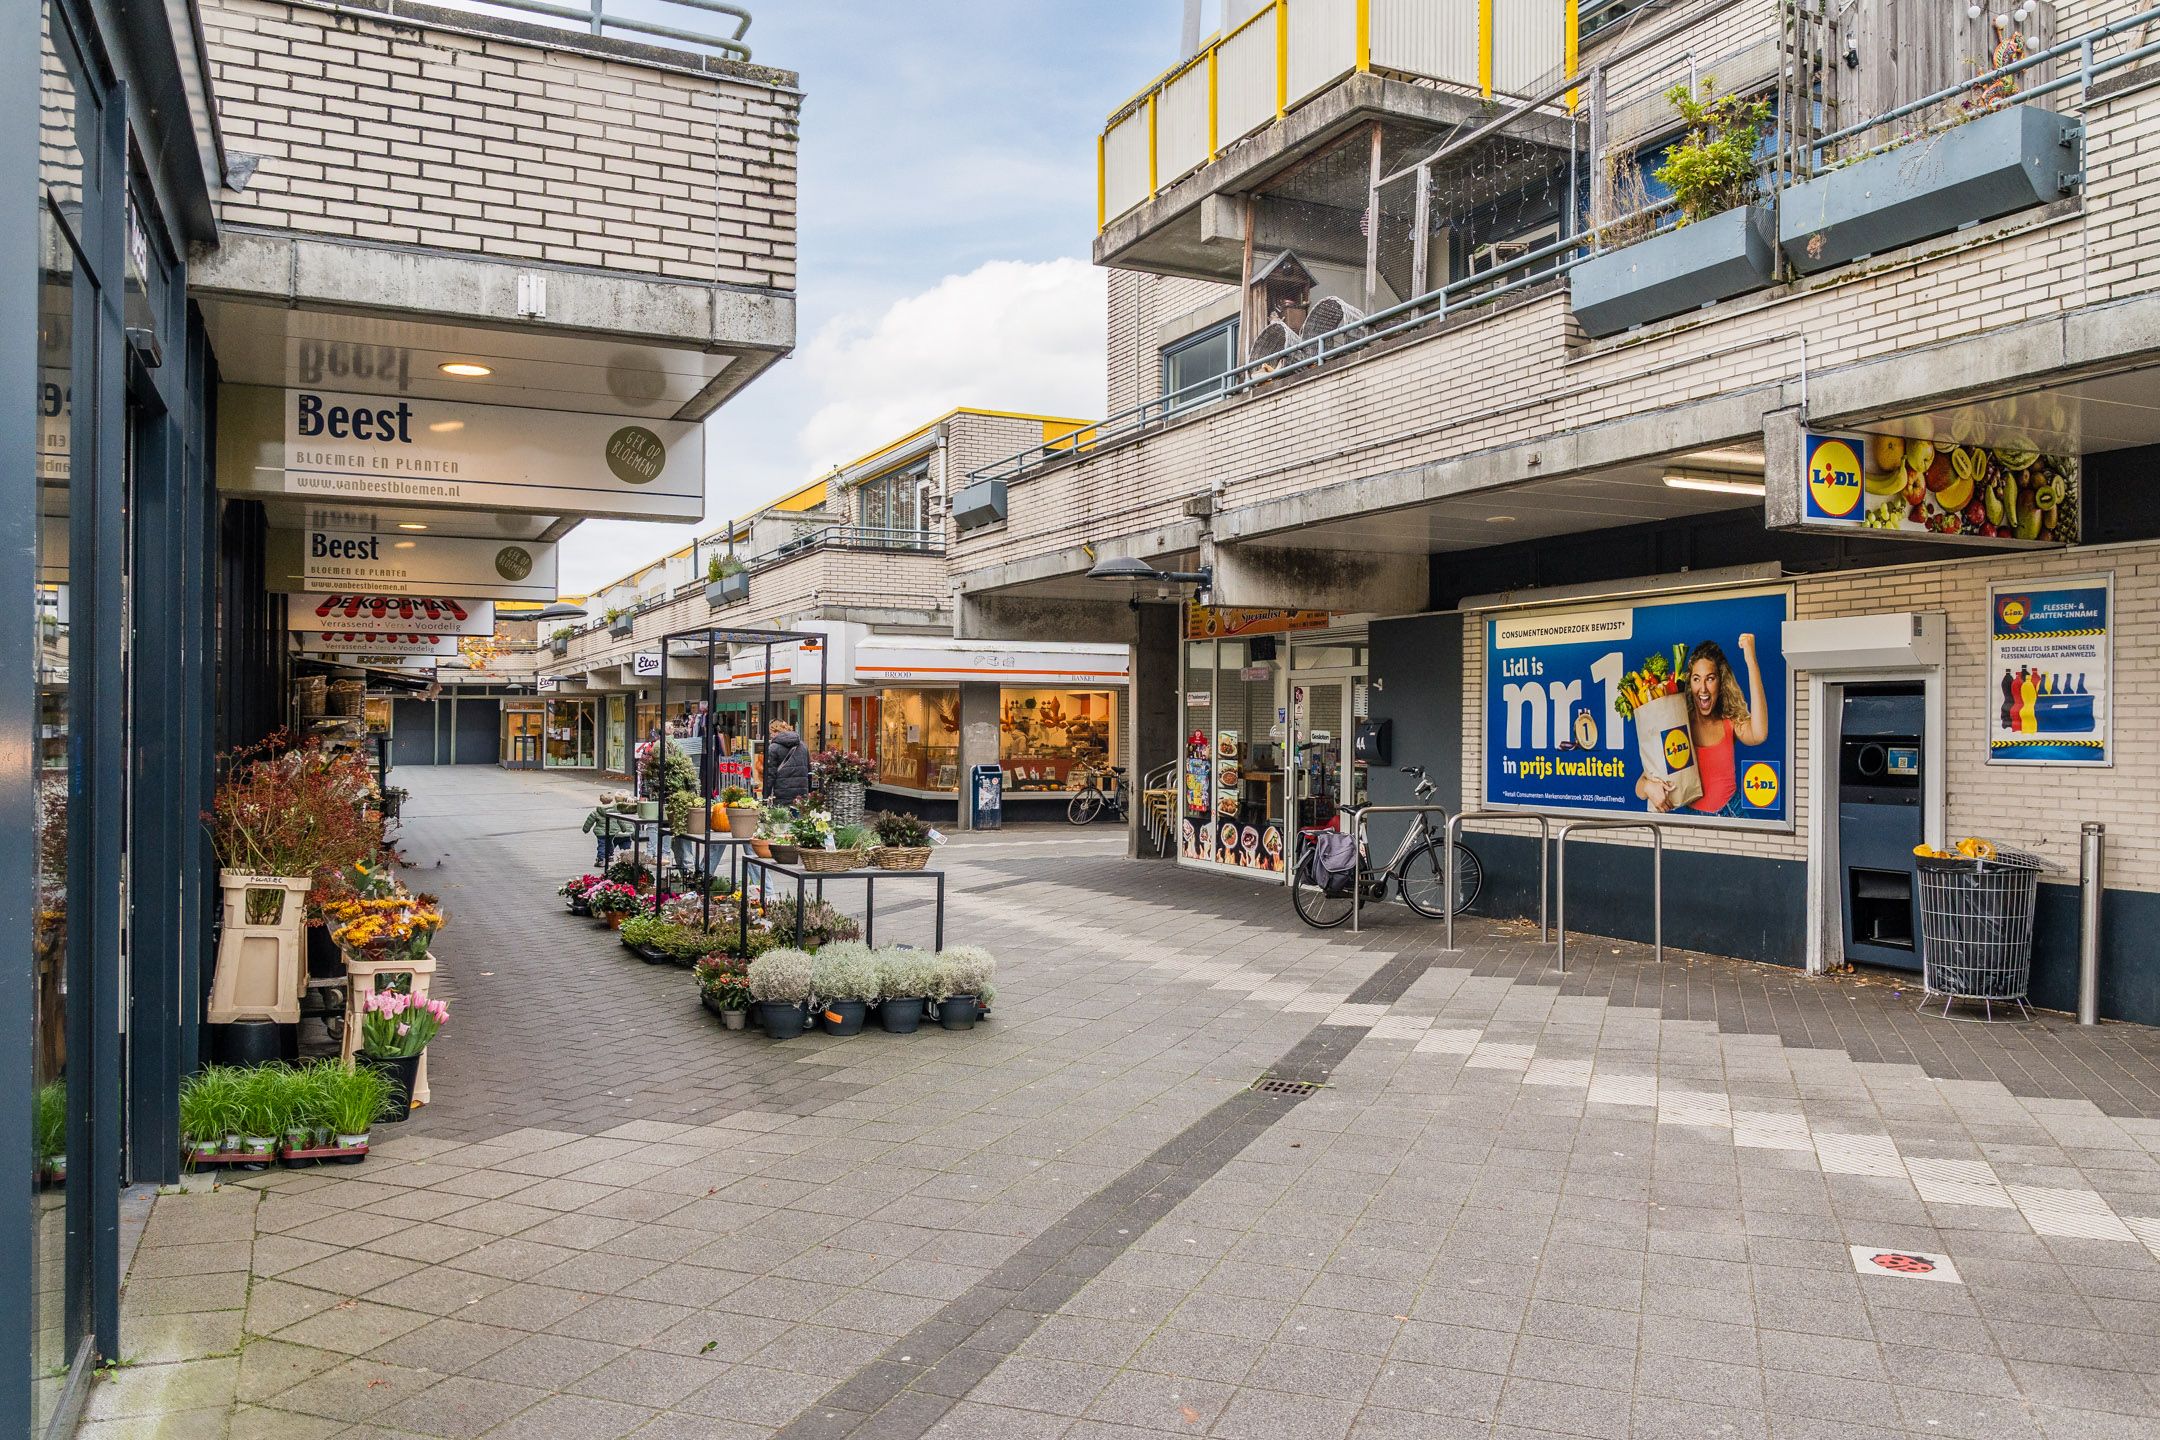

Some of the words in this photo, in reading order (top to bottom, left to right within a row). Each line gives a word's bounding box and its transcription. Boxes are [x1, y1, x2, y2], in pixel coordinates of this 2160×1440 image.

[298, 394, 413, 443] Beest
[626, 431, 647, 452] GEK
[646, 444, 661, 460] OP
[296, 451, 365, 468] BLOEMEN
[372, 456, 389, 469] EN
[396, 457, 459, 473] PLANTEN
[611, 440, 657, 478] BLOEMEN!
[297, 477, 461, 496] www.vanbeestbloemen.nl
[312, 533, 379, 560] Beest
[310, 566, 351, 575] BLOEMEN
[355, 568, 366, 576] EN
[369, 568, 407, 577] PLANTEN
[311, 581, 408, 592] www.vanbeestbloemen.nl
[322, 595, 351, 609] DE
[356, 596, 463, 612] KOOPMAN
[2078, 602, 2085, 610] &
[2029, 610, 2099, 620] KRATTEN-INNAME
[320, 619, 374, 629] Verrassend
[384, 621, 405, 629] Vers
[414, 622, 462, 632] Voordelig
[1501, 623, 1590, 639] CONSUMENTENONDERZOEK
[398, 645, 435, 653] Voordelig
[2000, 652, 2059, 660] FLESSENAUTOMAAT
[356, 655, 407, 665] EXPERT
[638, 656, 659, 669] Etos
[1502, 657, 1529, 677] Lidl
[1531, 656, 1544, 676] is
[1356, 736, 1366, 750] 44
[1502, 755, 1517, 774] in
[1520, 755, 1553, 780] prijs
[1555, 756, 1625, 778] kwaliteit
[1516, 791, 1544, 799] Consumenten
[1544, 792, 1582, 801] Merkenonderzoek
